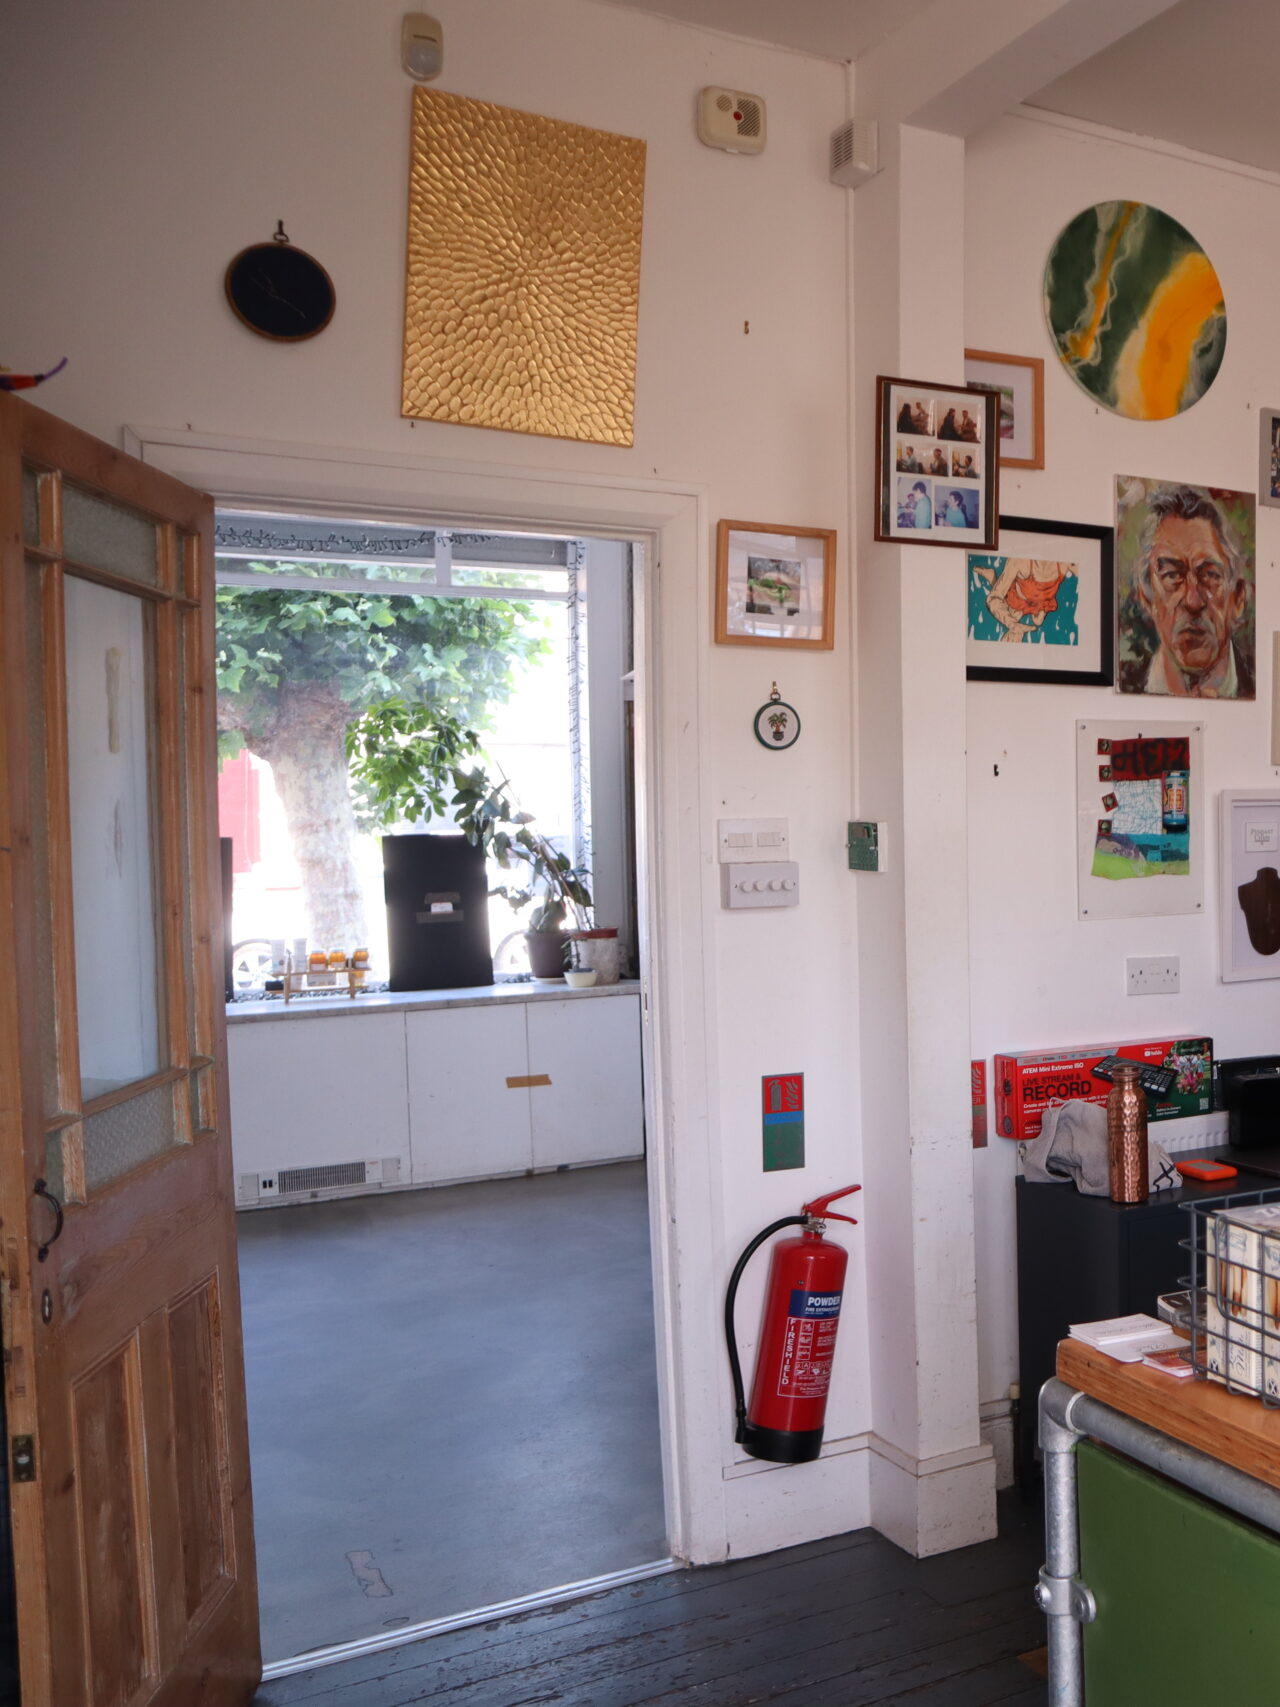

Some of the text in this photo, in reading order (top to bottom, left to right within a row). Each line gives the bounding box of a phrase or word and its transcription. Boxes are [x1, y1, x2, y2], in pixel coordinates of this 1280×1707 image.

[1022, 1067, 1039, 1075] ATEM
[1039, 1065, 1051, 1073] Mini
[1051, 1063, 1074, 1072] Extreme
[1023, 1077, 1040, 1087] LIVE
[1042, 1074, 1075, 1085] STREAM
[1023, 1080, 1092, 1103] RECORD
[807, 1296, 841, 1306] POWDER
[781, 1318, 797, 1385] FIRESHIELD
